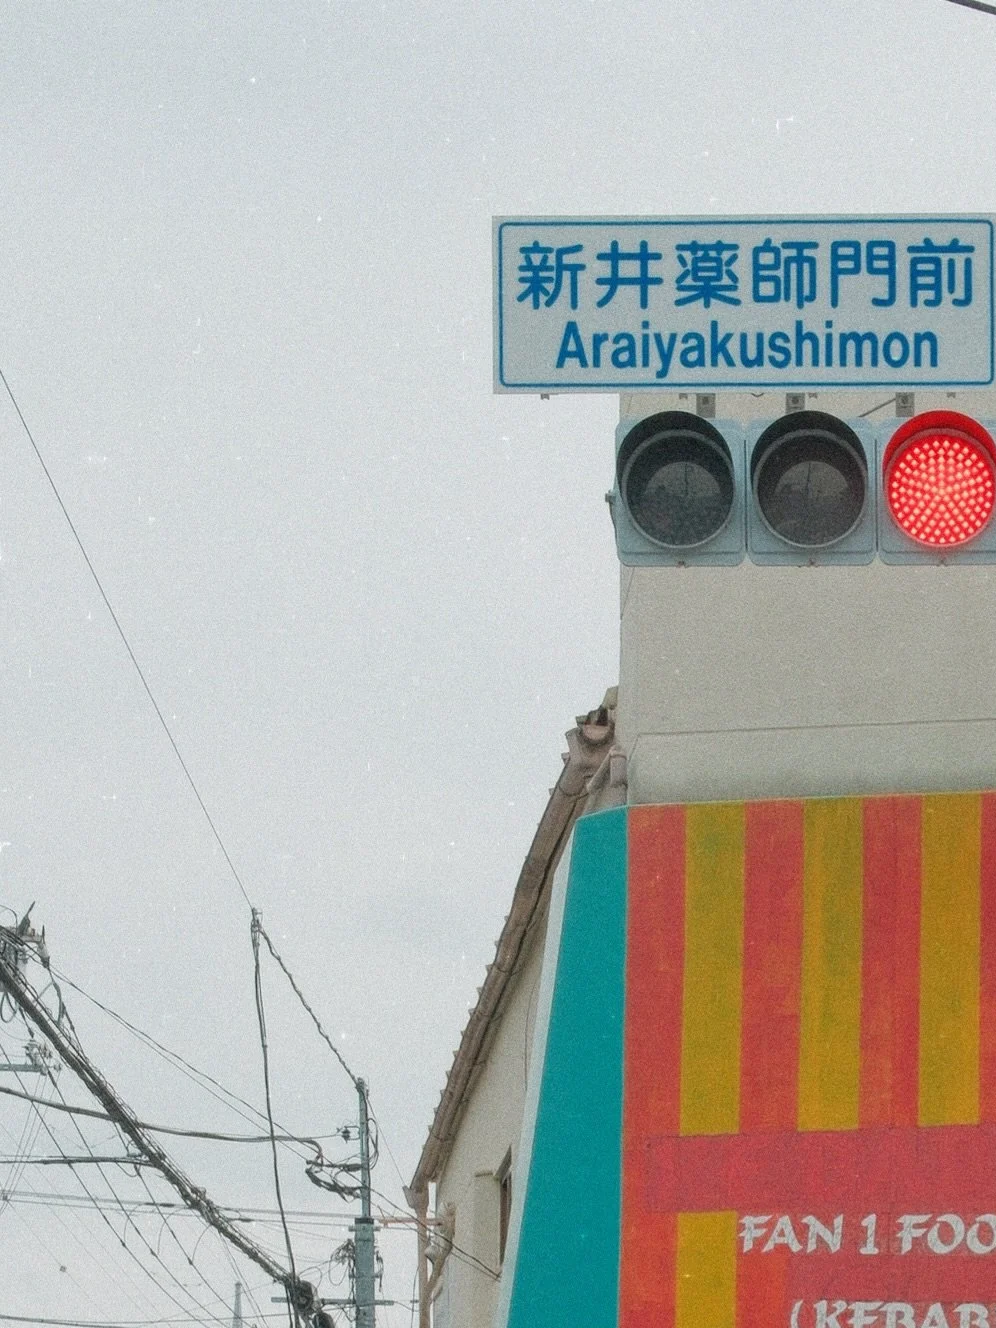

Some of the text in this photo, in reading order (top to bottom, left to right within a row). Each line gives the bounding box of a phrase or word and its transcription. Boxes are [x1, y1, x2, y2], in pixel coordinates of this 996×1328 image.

[516, 238, 976, 310] 新井薬師門前
[555, 320, 939, 378] Araiyakushimon
[739, 1213, 844, 1254] FAN
[859, 1213, 880, 1254] 1
